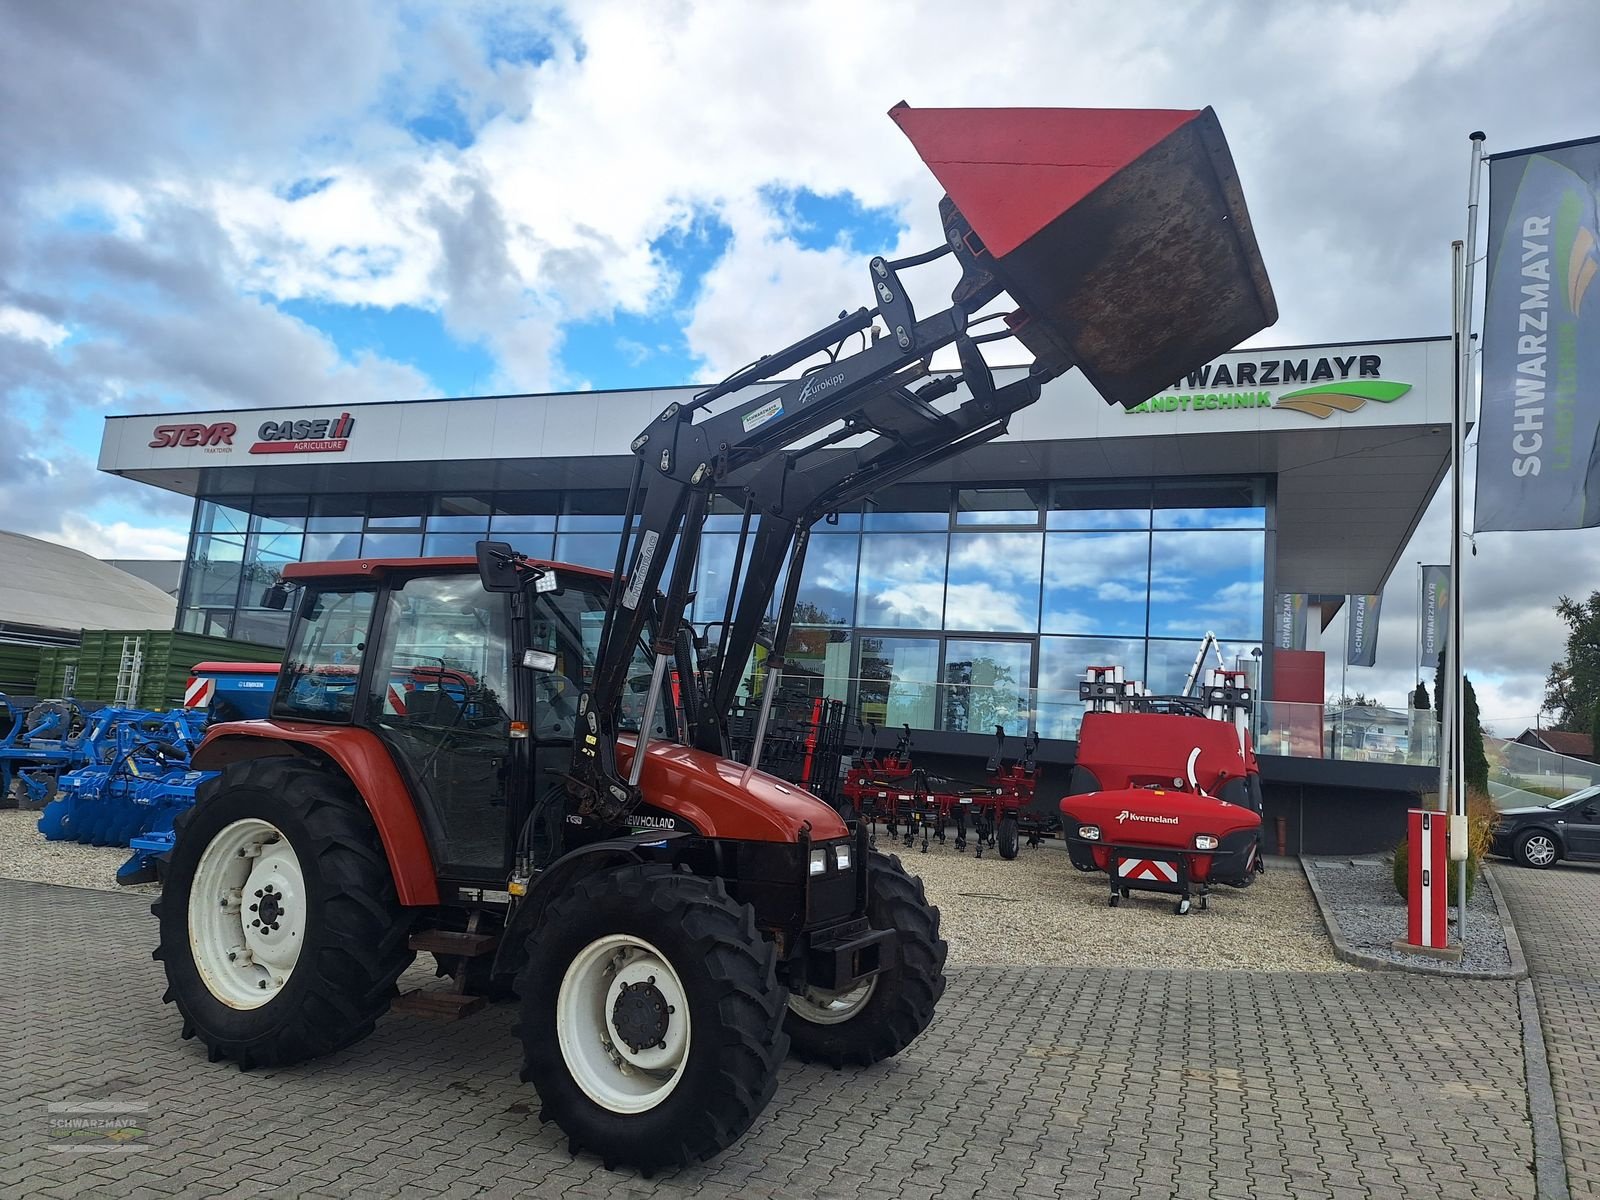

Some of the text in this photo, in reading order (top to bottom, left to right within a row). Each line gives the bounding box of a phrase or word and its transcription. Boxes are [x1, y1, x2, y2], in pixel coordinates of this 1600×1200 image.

[1512, 215, 1552, 478] SCHWARZMAYR
[799, 372, 845, 403] Eurokipp
[1173, 354, 1382, 391] WARZMAYR
[148, 422, 237, 448] STEYR
[257, 419, 330, 441] CASE
[293, 441, 342, 450] AGRICULTURE
[633, 535, 658, 598] HYDRAC
[1355, 595, 1366, 653] SCHWARZMA
[1426, 583, 1437, 654] SCHWARZMAYR
[641, 817, 675, 829] HOLLAND
[1129, 812, 1179, 824] Kverneland
